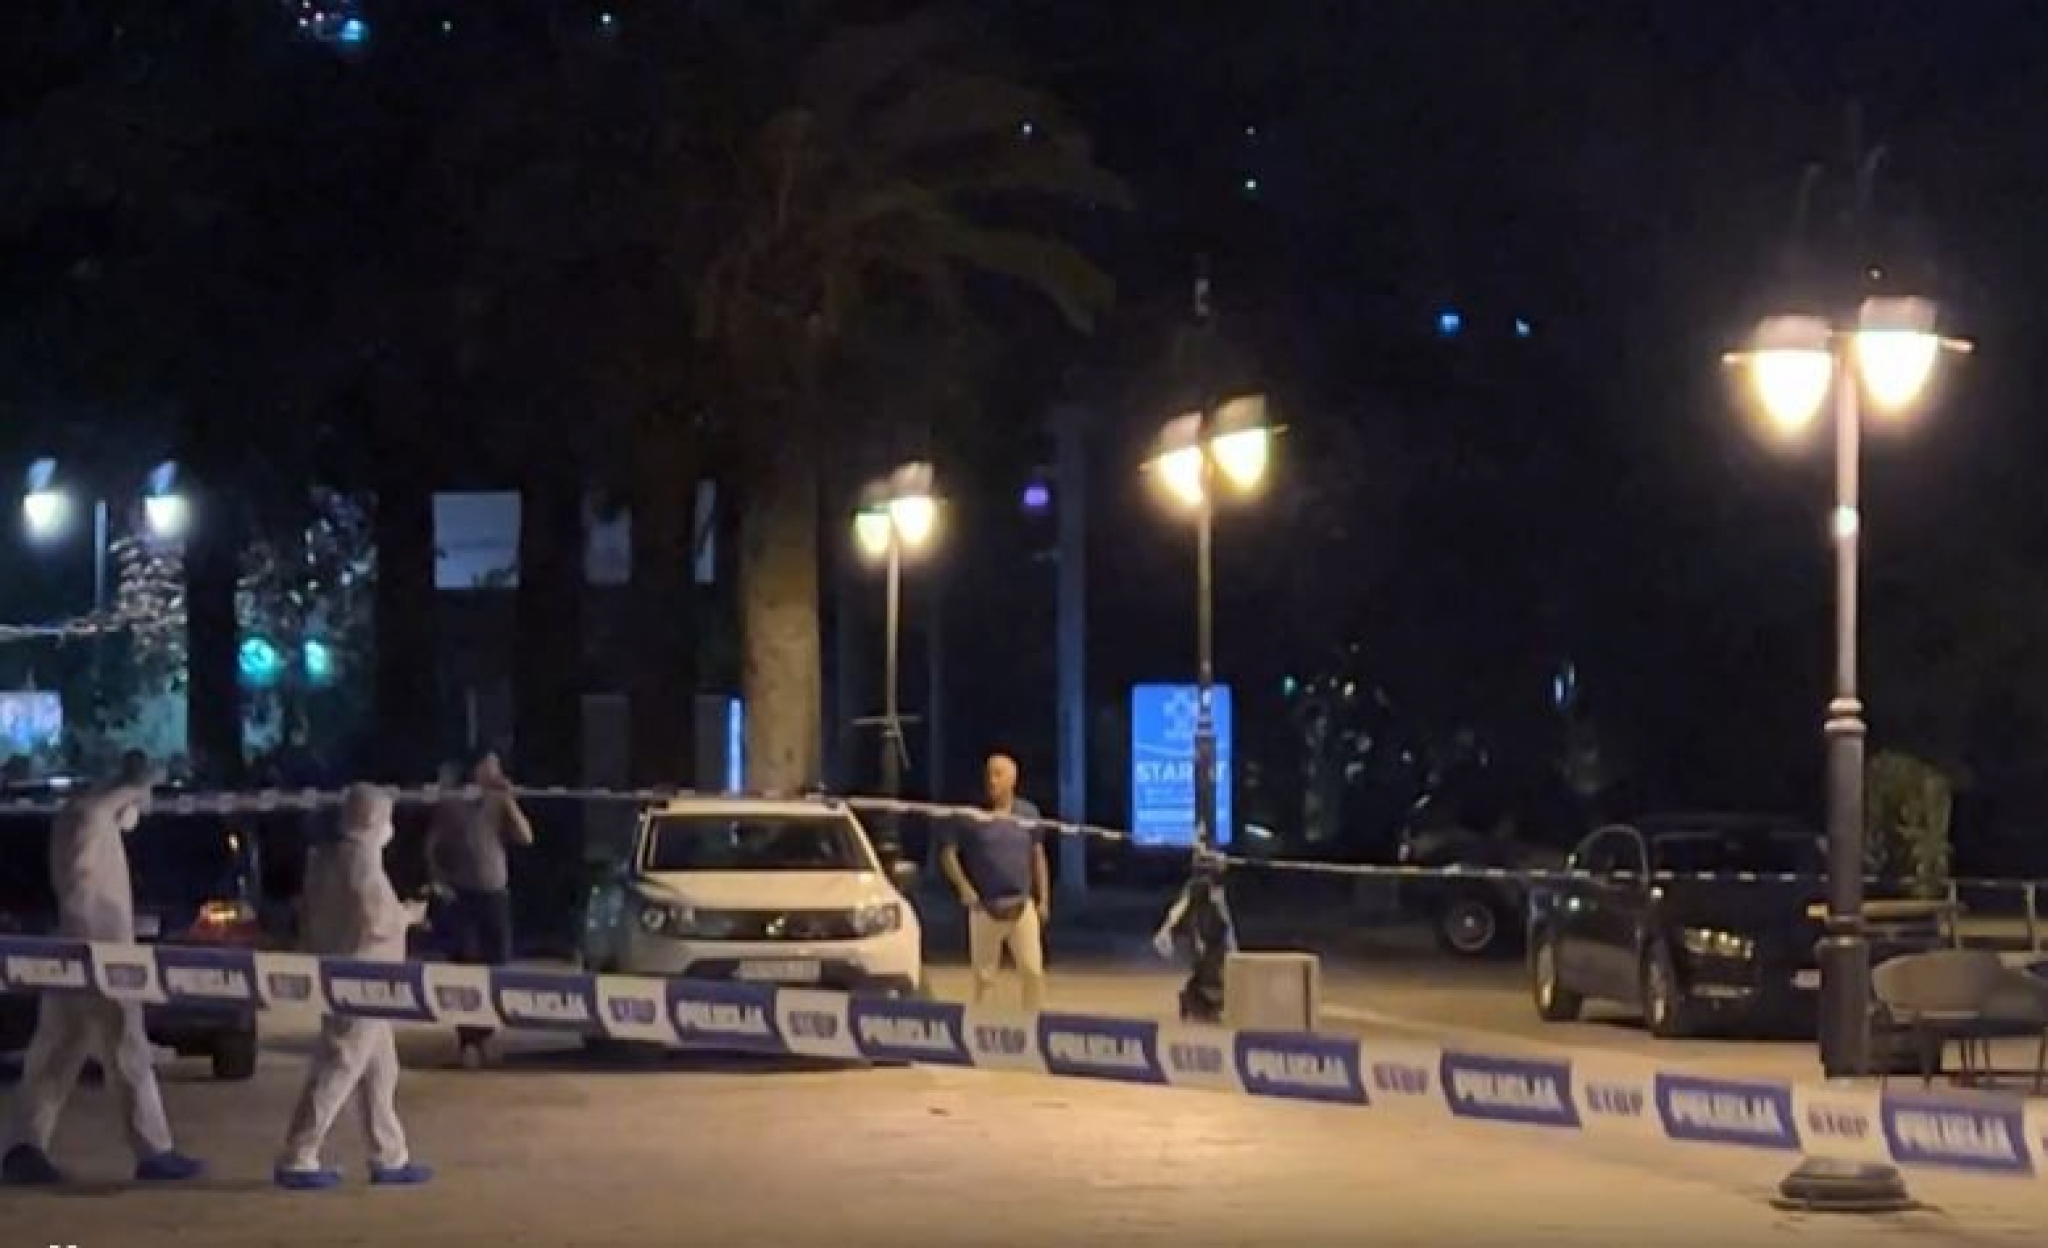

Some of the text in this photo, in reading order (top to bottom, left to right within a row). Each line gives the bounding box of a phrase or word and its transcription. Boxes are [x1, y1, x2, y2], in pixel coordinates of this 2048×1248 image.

[858, 1014, 956, 1050] POLICIJA
[1048, 1031, 1149, 1068] POLICIJA
[1247, 1048, 1350, 1086] POLICIJA
